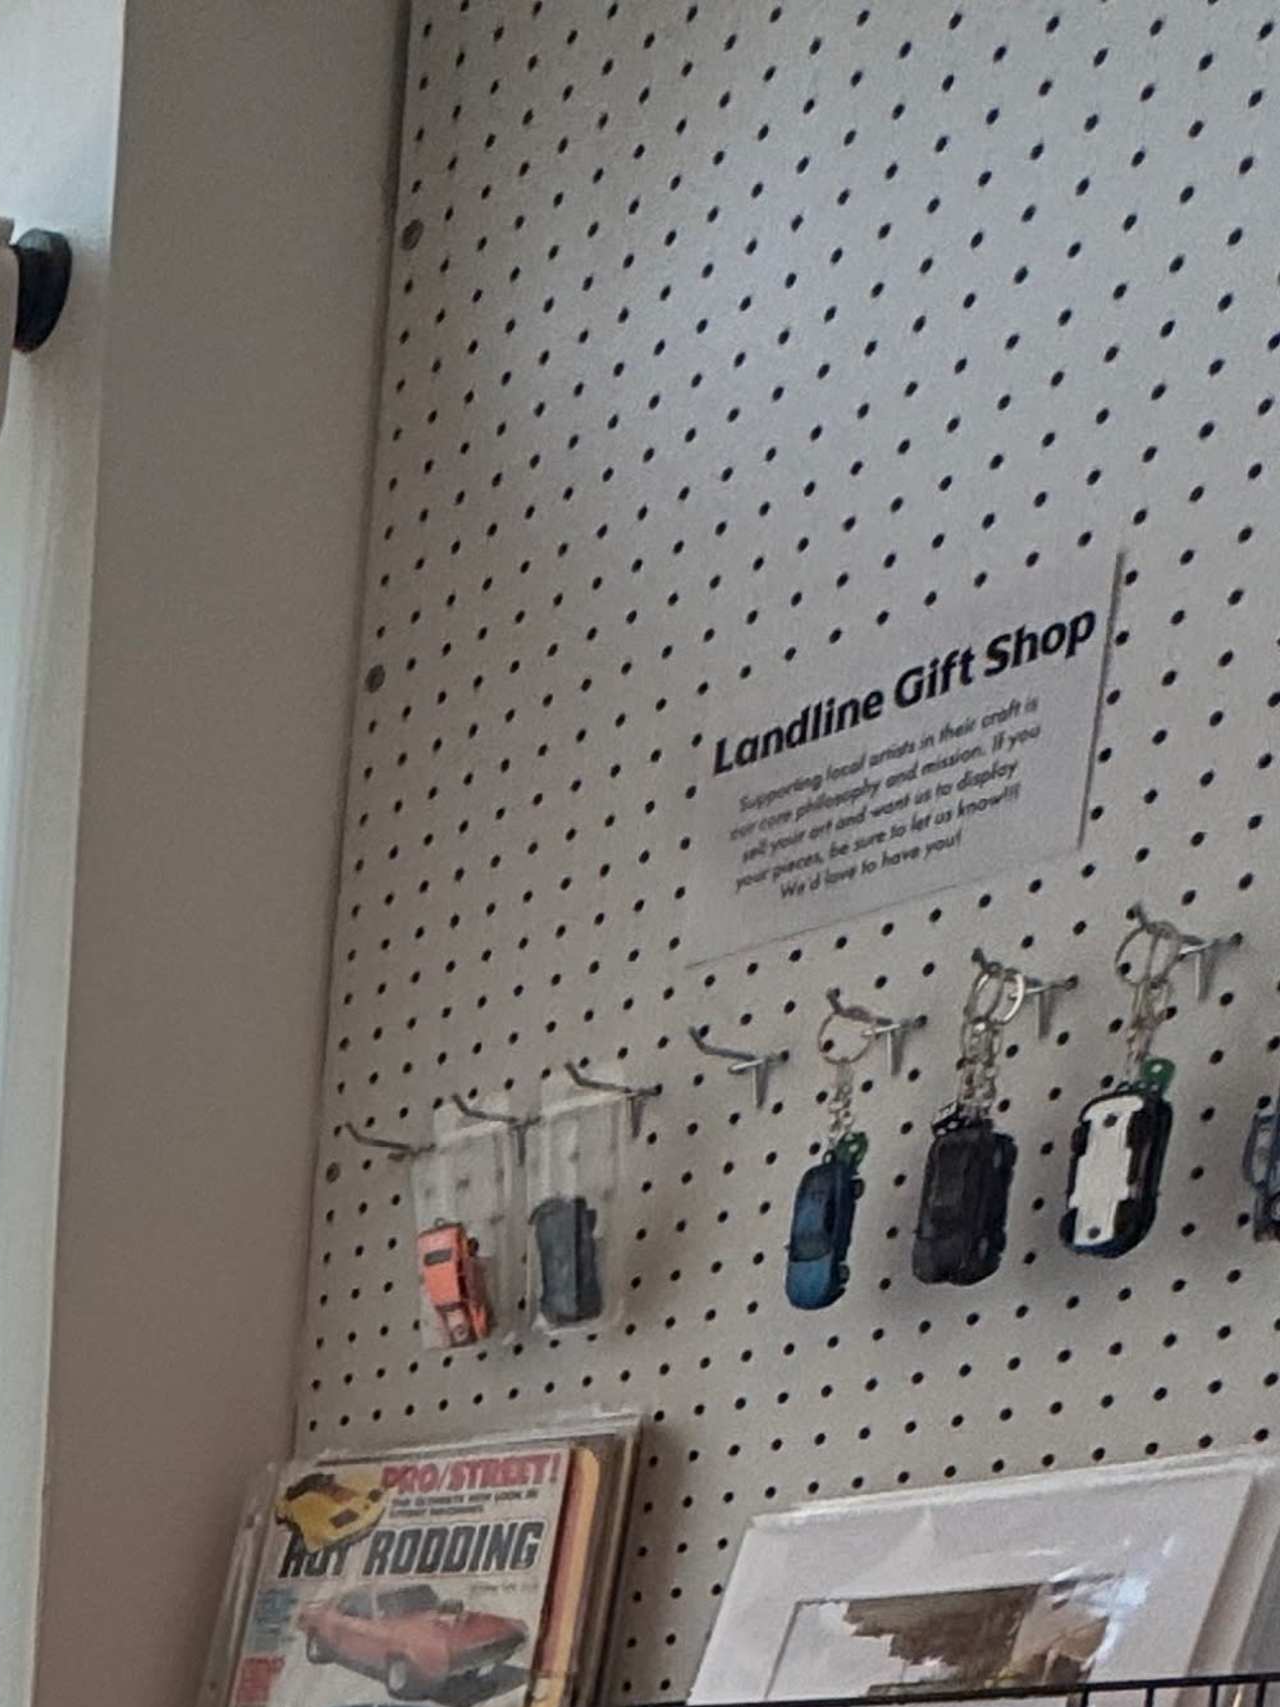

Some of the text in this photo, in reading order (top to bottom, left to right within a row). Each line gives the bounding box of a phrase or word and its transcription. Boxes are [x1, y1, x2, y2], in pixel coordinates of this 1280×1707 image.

[713, 611, 1097, 777] Landline Gift Shop
[739, 697, 1039, 812] Supporting local artists in their craft is
[759, 811, 792, 830] core
[795, 777, 882, 822] philosophy
[886, 761, 919, 788] and
[992, 731, 1006, 753] If
[1008, 726, 1041, 751] you
[736, 868, 770, 894] your
[830, 842, 849, 858] be
[853, 831, 887, 852] sure
[890, 825, 907, 839] to
[911, 810, 932, 832] let
[934, 810, 953, 826] us
[742, 760, 1019, 863] sell your art and want us to display
[824, 867, 857, 884] love
[860, 859, 878, 875] to
[881, 847, 920, 868] have
[924, 828, 962, 861] you!
[362, 1521, 545, 1576] RODDING
